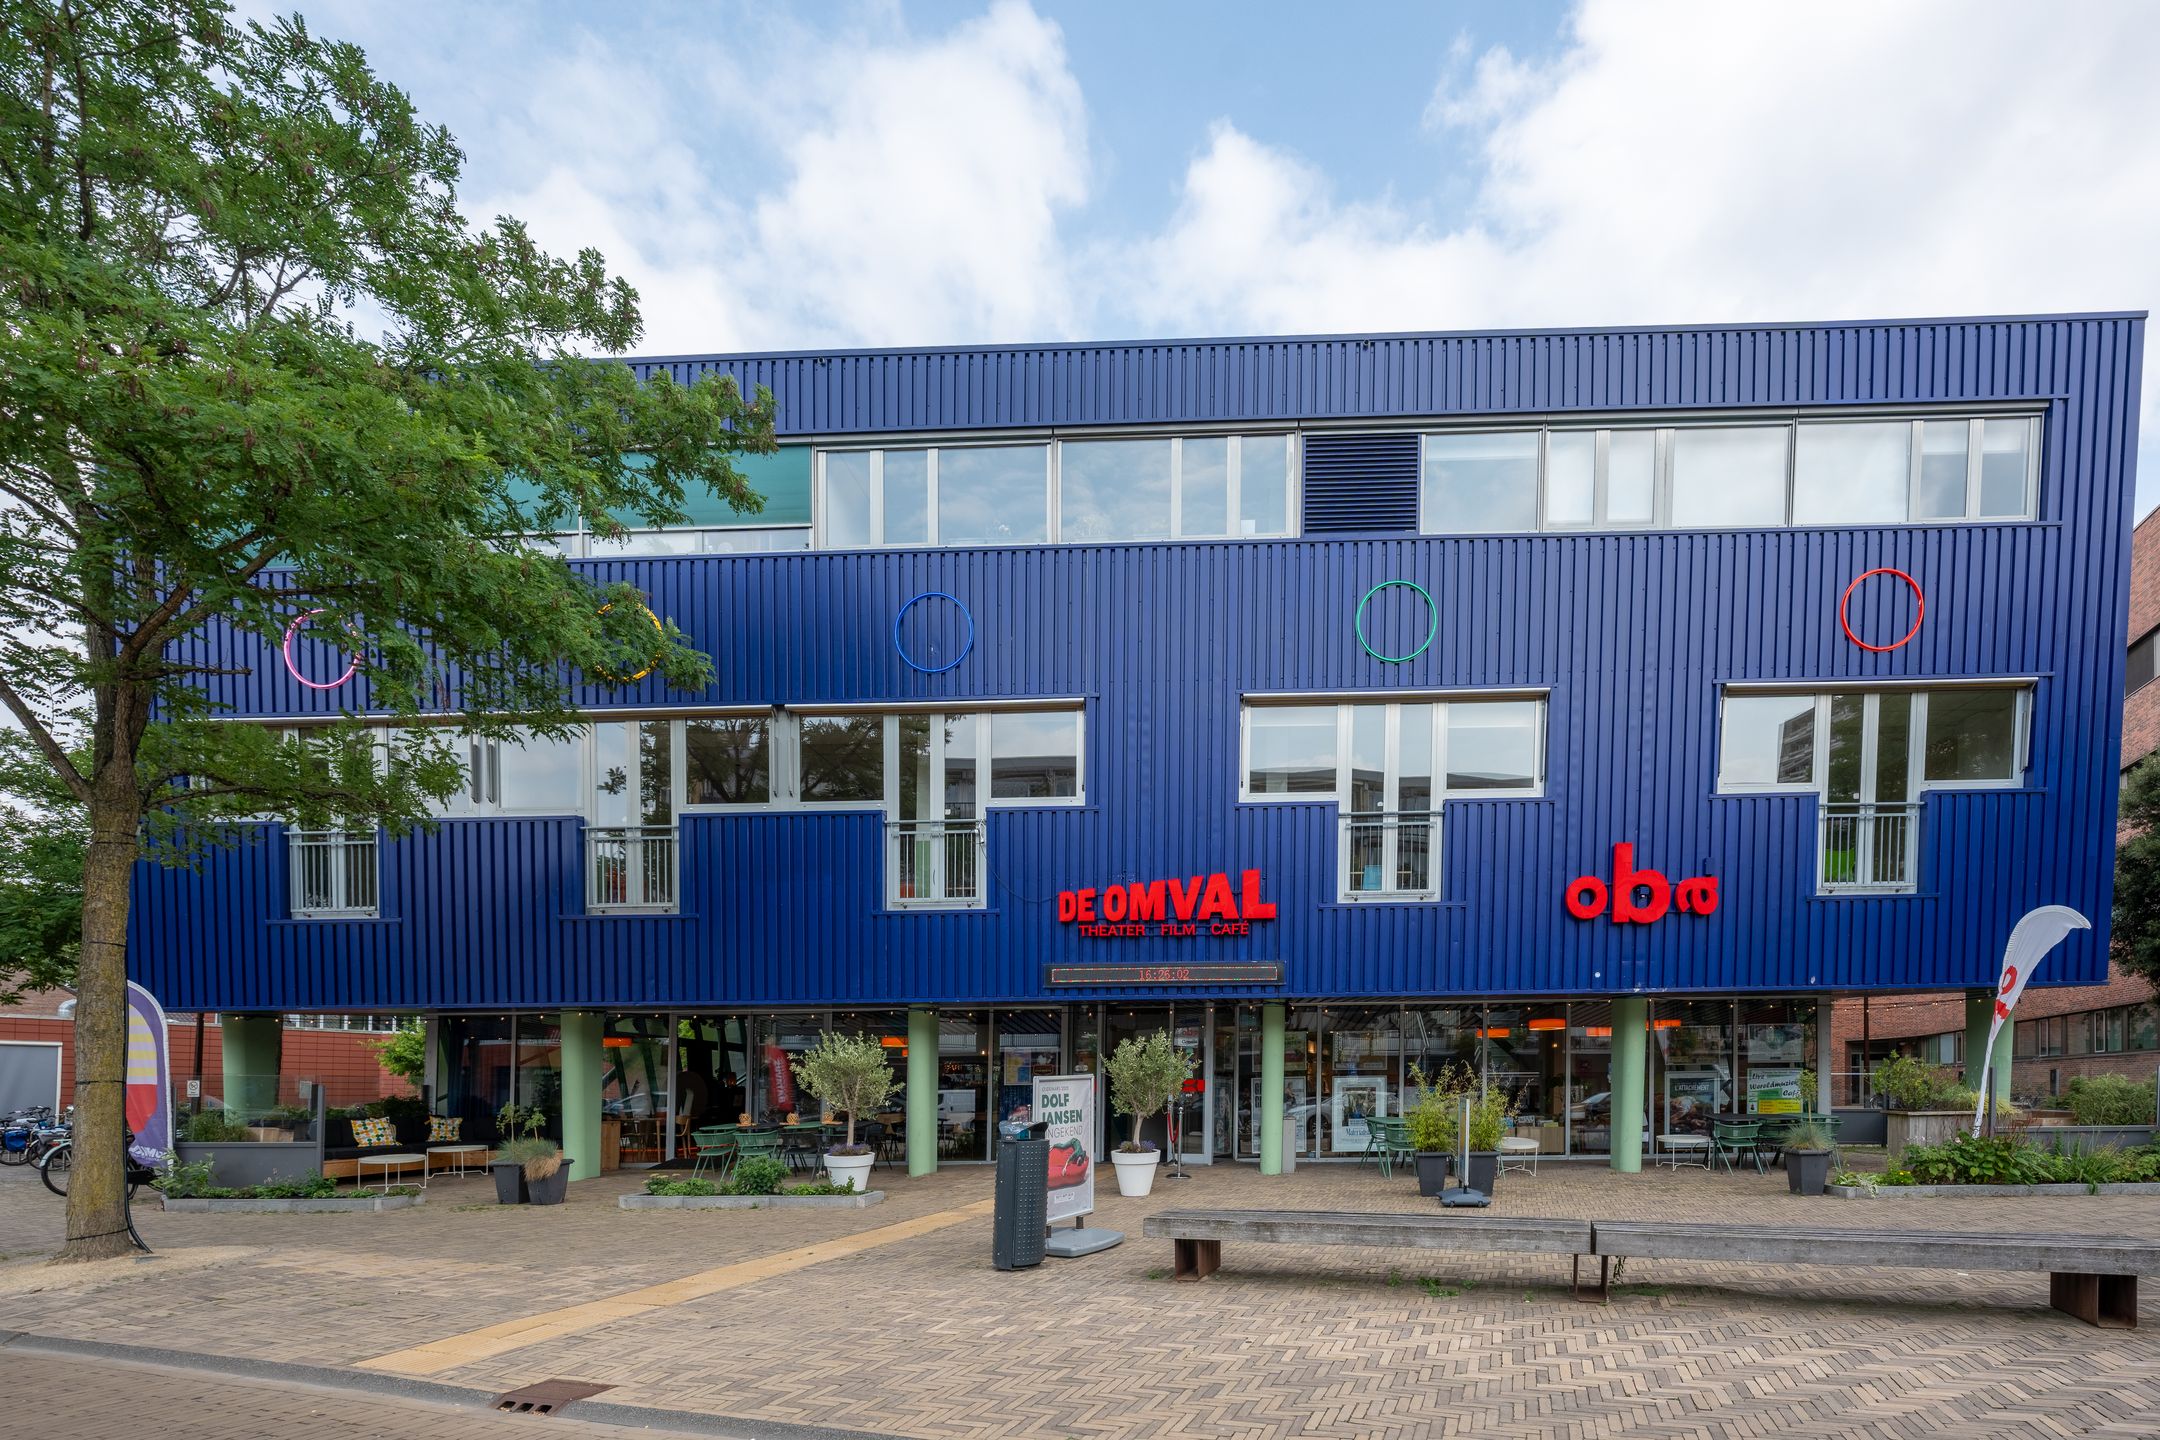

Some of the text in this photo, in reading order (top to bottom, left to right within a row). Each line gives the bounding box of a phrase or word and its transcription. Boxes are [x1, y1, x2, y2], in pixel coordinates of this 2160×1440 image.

[1565, 842, 1719, 924] oba
[1058, 869, 1276, 922] DE OMVAL
[1079, 920, 1249, 937] THEATER FILM CAFÉ
[1139, 969, 1190, 980] 16:26:02
[1041, 1093, 1070, 1108] DOLF
[1042, 1109, 1083, 1125] JANSEN
[1047, 1126, 1083, 1138] NGEKEND
